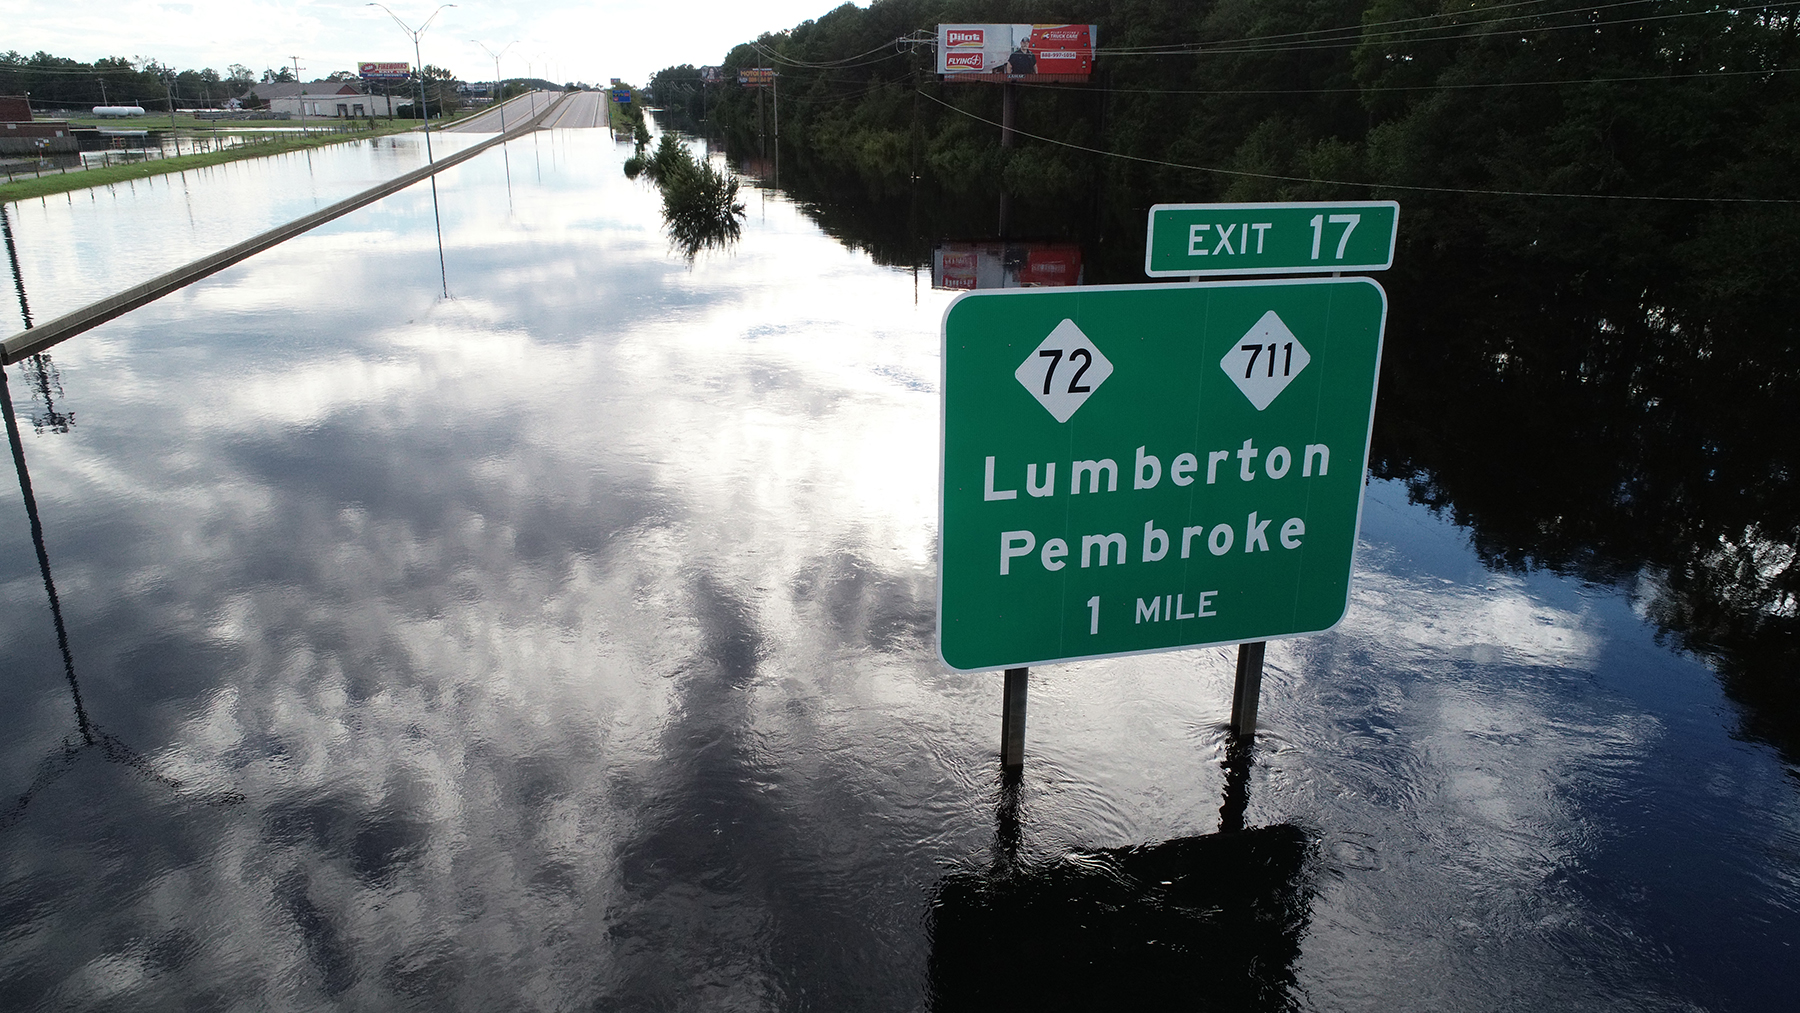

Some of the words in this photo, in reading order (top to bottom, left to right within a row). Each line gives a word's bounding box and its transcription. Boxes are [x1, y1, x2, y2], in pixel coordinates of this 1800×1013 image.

[948, 57, 972, 65] FLYING
[1189, 223, 1273, 256] EXIT
[1310, 214, 1361, 260] 17
[1039, 348, 1093, 396] 72
[1241, 342, 1293, 379] 711
[984, 438, 1330, 501] Lumberton
[1000, 511, 1306, 576] Pembroke
[1087, 595, 1100, 635] 1
[1135, 590, 1219, 624] MILE
